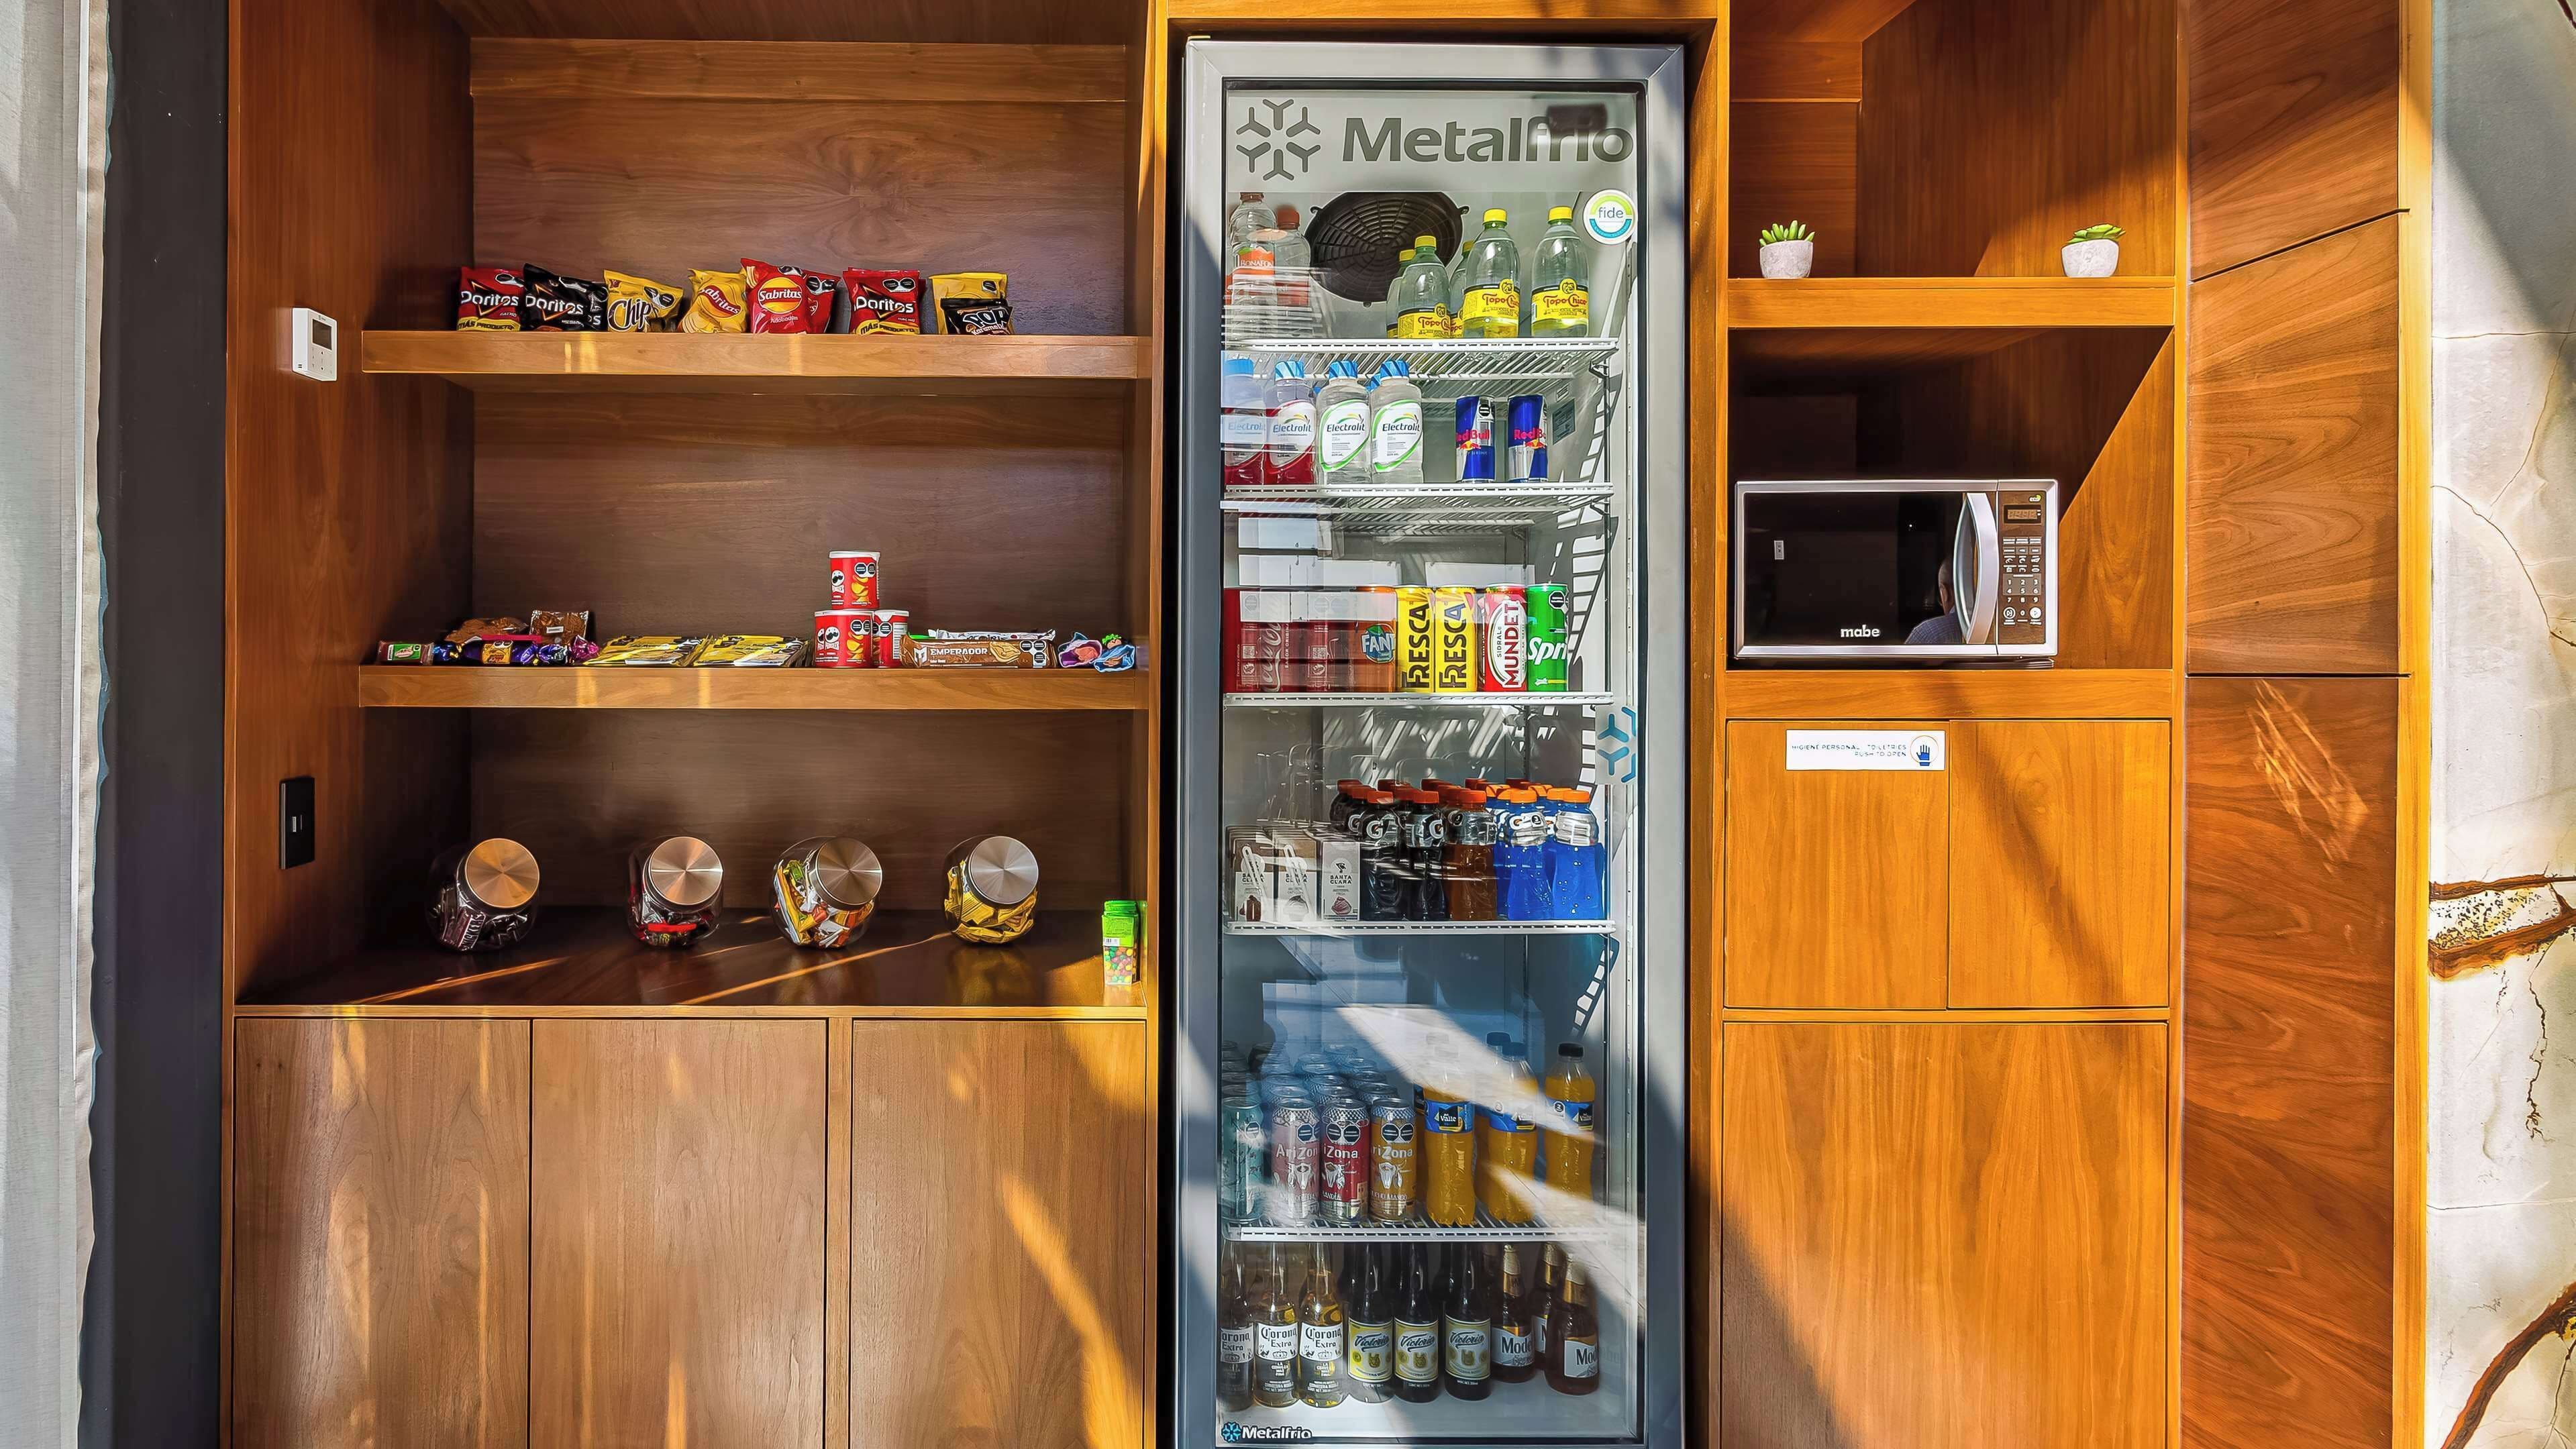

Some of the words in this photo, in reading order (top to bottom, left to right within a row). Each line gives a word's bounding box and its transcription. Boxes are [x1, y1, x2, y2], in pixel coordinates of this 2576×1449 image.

[1342, 115, 1634, 163] Metalfrio
[1598, 207, 1624, 219] fide
[461, 290, 519, 307] Doritos
[759, 288, 802, 302] Sabritas
[1482, 293, 1506, 306] Topo
[1543, 294, 1567, 308] Topo
[1567, 294, 1588, 307] Chico
[526, 294, 584, 315] Doritos
[856, 296, 914, 313] Doritos
[860, 321, 878, 334] MÁS
[1418, 316, 1441, 329] Topo
[1273, 422, 1312, 433] Electrolit
[1327, 422, 1366, 433] Electrolit
[1382, 421, 1421, 433] Electrolit
[1514, 428, 1536, 440] Red
[1841, 625, 1880, 638] mabe
[930, 647, 988, 656] EMPERADOR
[1401, 602, 1430, 688] FRESCA
[1439, 602, 1467, 688] FRESCA
[1504, 603, 1519, 686] MUNDET
[1366, 820, 1384, 839] G
[1261, 1326, 1298, 1340] Corona
[1305, 1326, 1343, 1340] Corona
[1449, 1331, 1485, 1349] Victoria
[1271, 1339, 1292, 1348] Extra
[1315, 1340, 1337, 1348] Extra
[1354, 1332, 1390, 1352] Victoria
[1400, 1332, 1435, 1352] Victoria
[1242, 1426, 1312, 1440] Metalfrio
